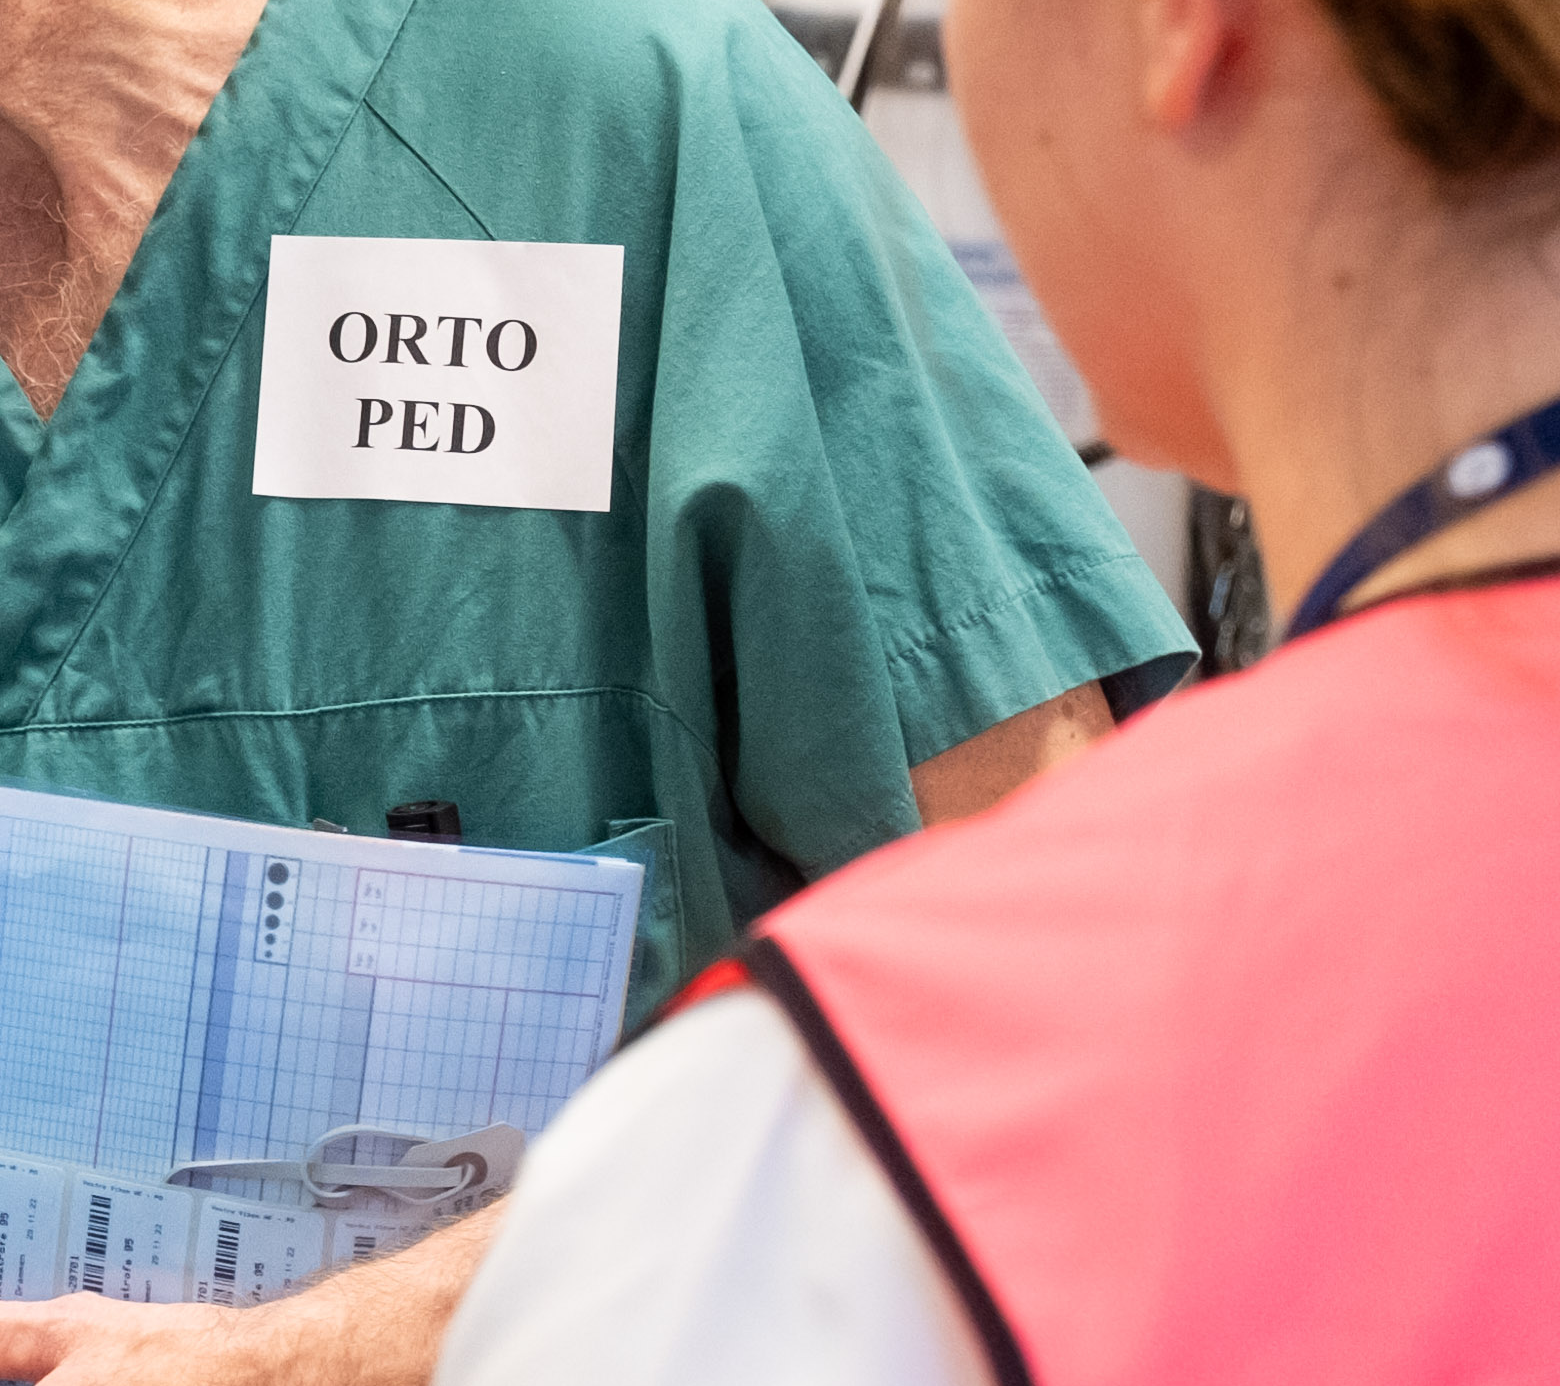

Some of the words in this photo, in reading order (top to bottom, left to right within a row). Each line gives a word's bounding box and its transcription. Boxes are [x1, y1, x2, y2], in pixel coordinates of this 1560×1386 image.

[328, 311, 538, 371] ORTO
[351, 398, 496, 454] PED
[123, 1237, 135, 1252] 95
[253, 1261, 265, 1277] 95
